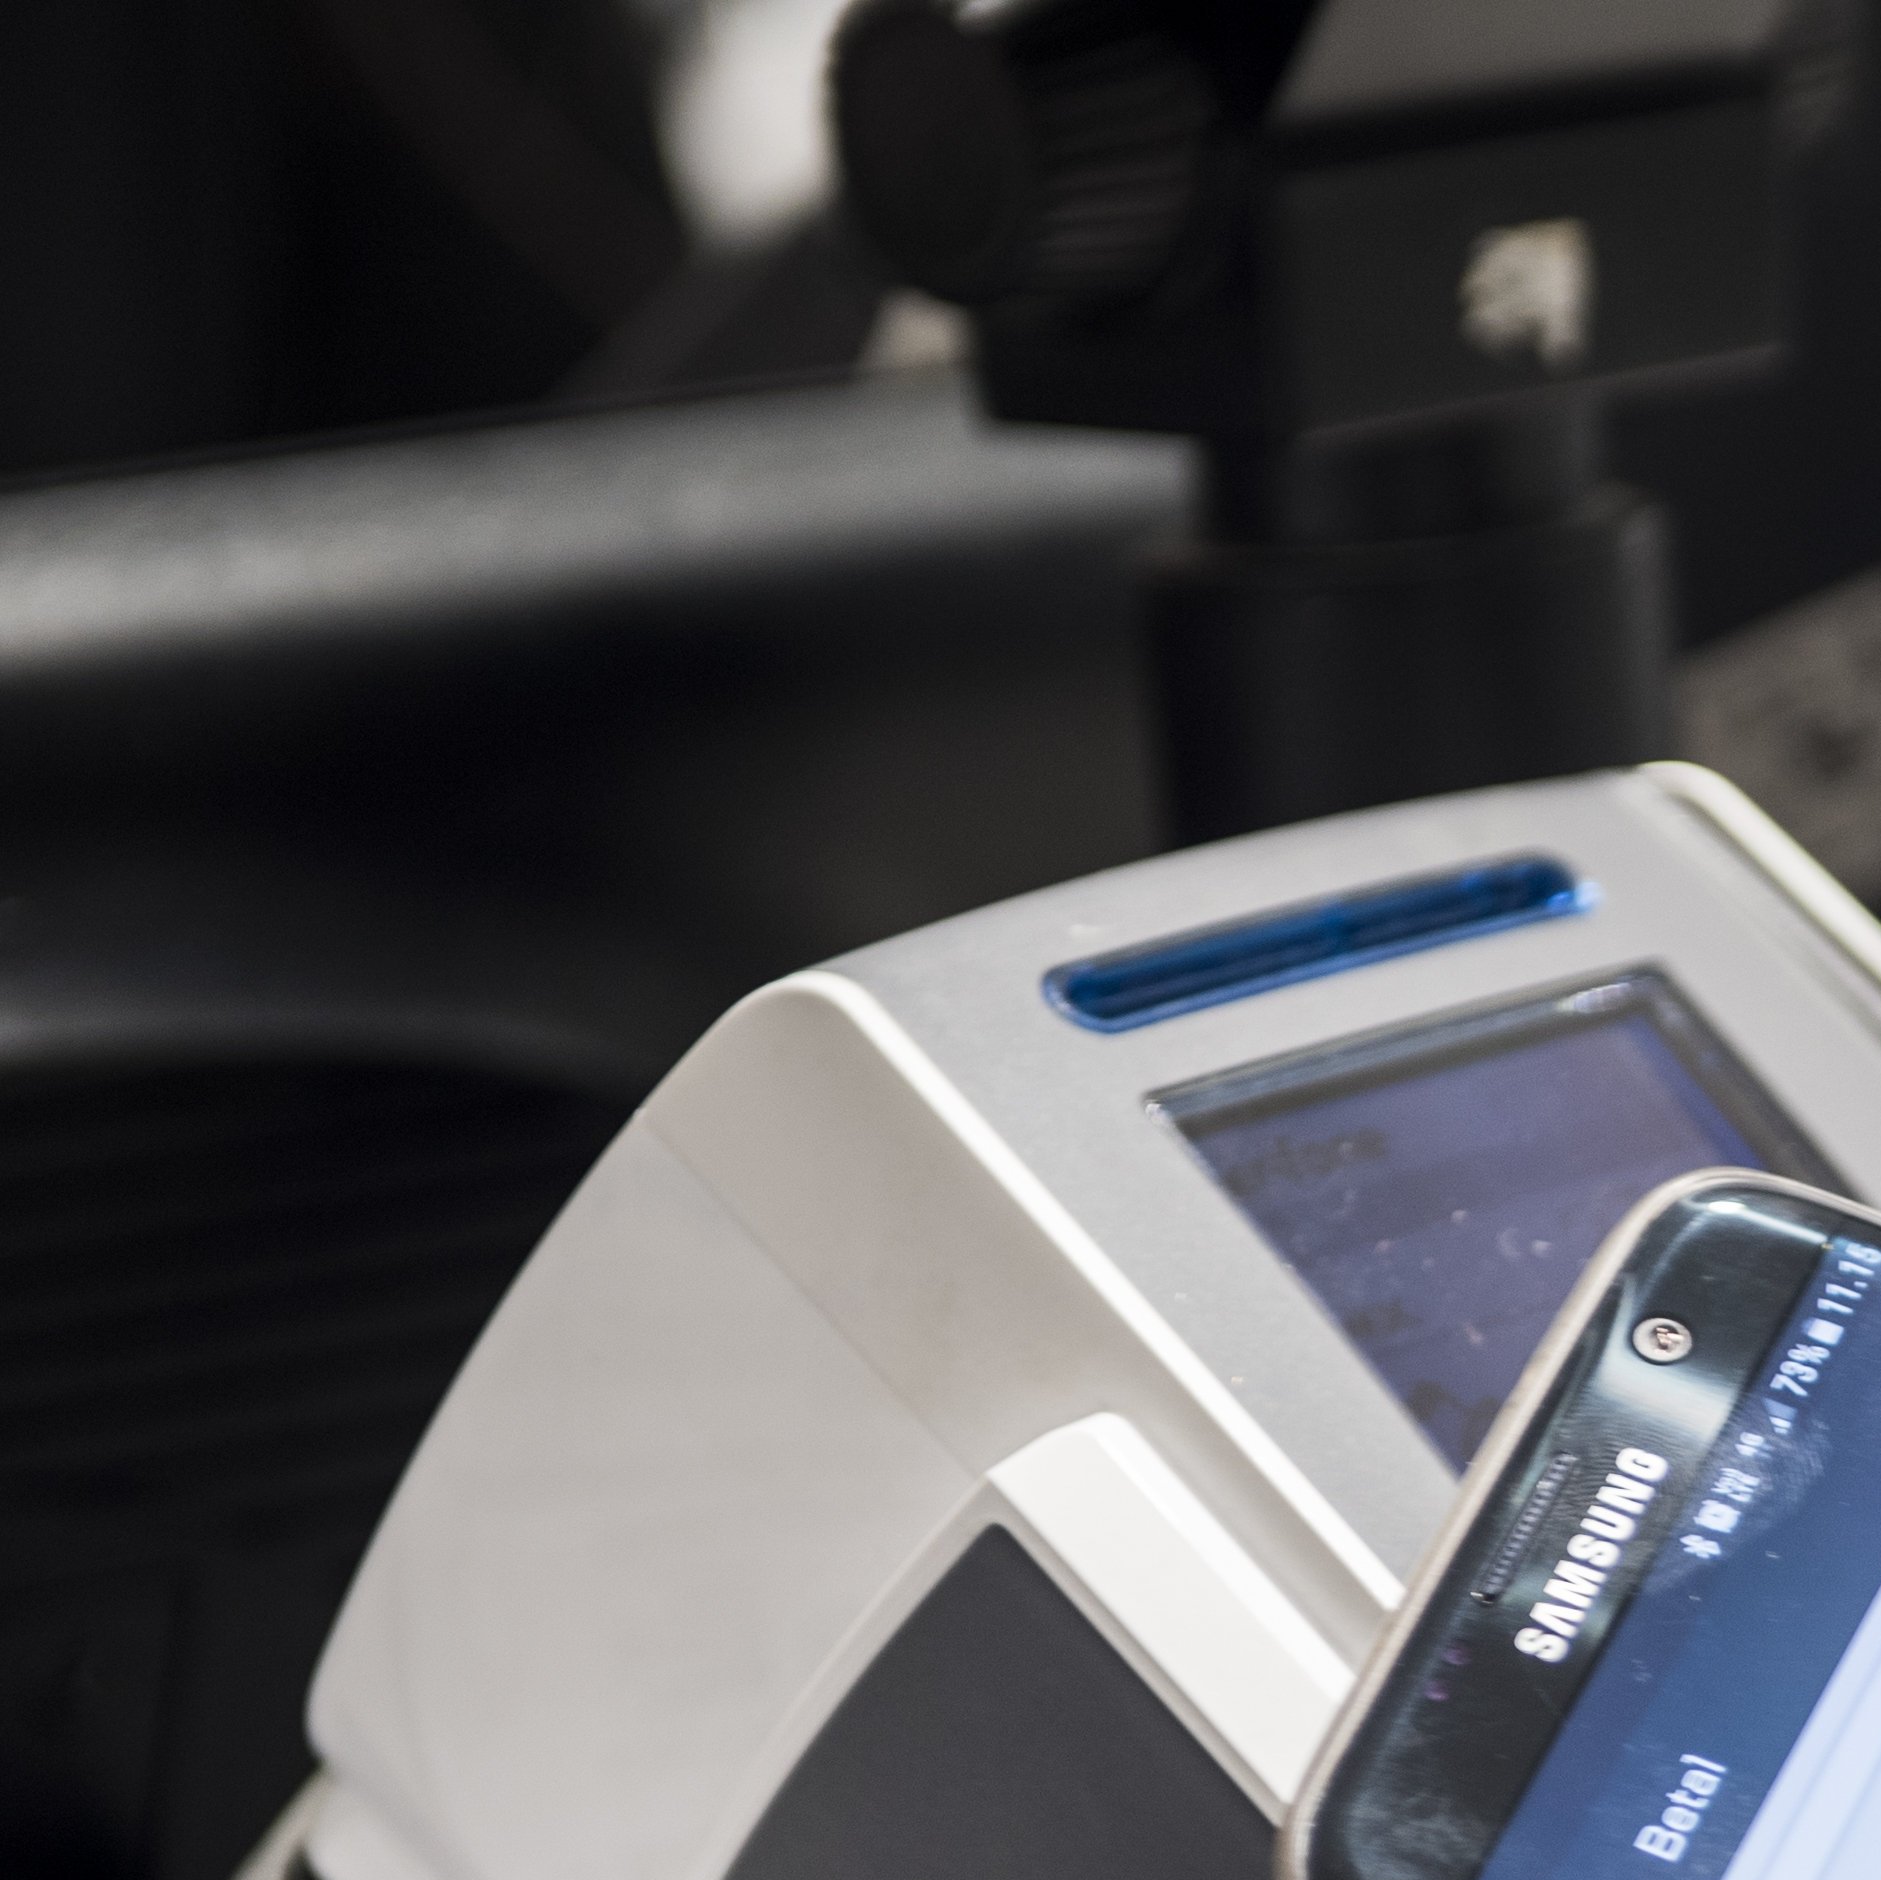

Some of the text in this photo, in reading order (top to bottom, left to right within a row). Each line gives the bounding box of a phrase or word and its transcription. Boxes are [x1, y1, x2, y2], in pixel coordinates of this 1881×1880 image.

[1768, 1343, 1831, 1398] 73%
[1514, 1446, 1670, 1663] SAMSUNG
[1632, 1753, 1729, 1863] Betal
